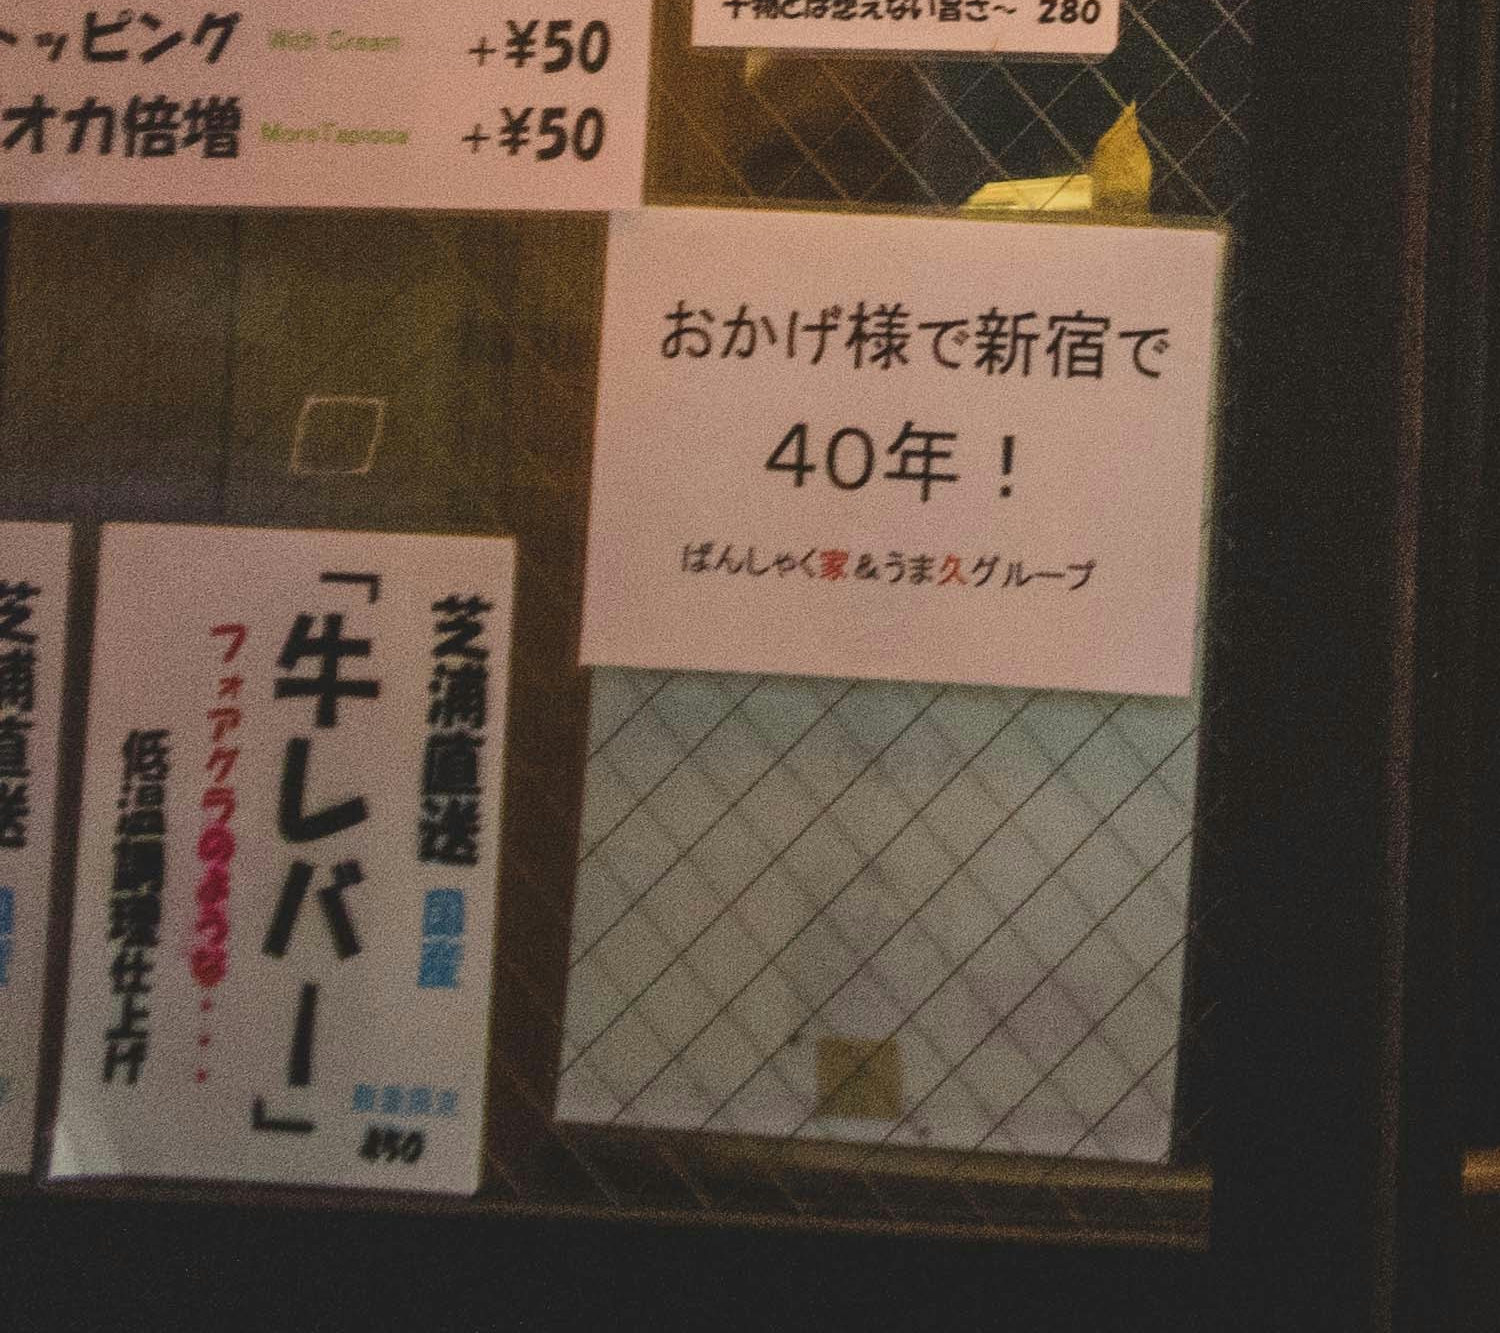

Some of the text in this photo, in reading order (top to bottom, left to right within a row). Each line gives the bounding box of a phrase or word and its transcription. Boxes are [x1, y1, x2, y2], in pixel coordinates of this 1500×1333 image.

[660, 299, 1172, 381] おかげ様で新宿で
